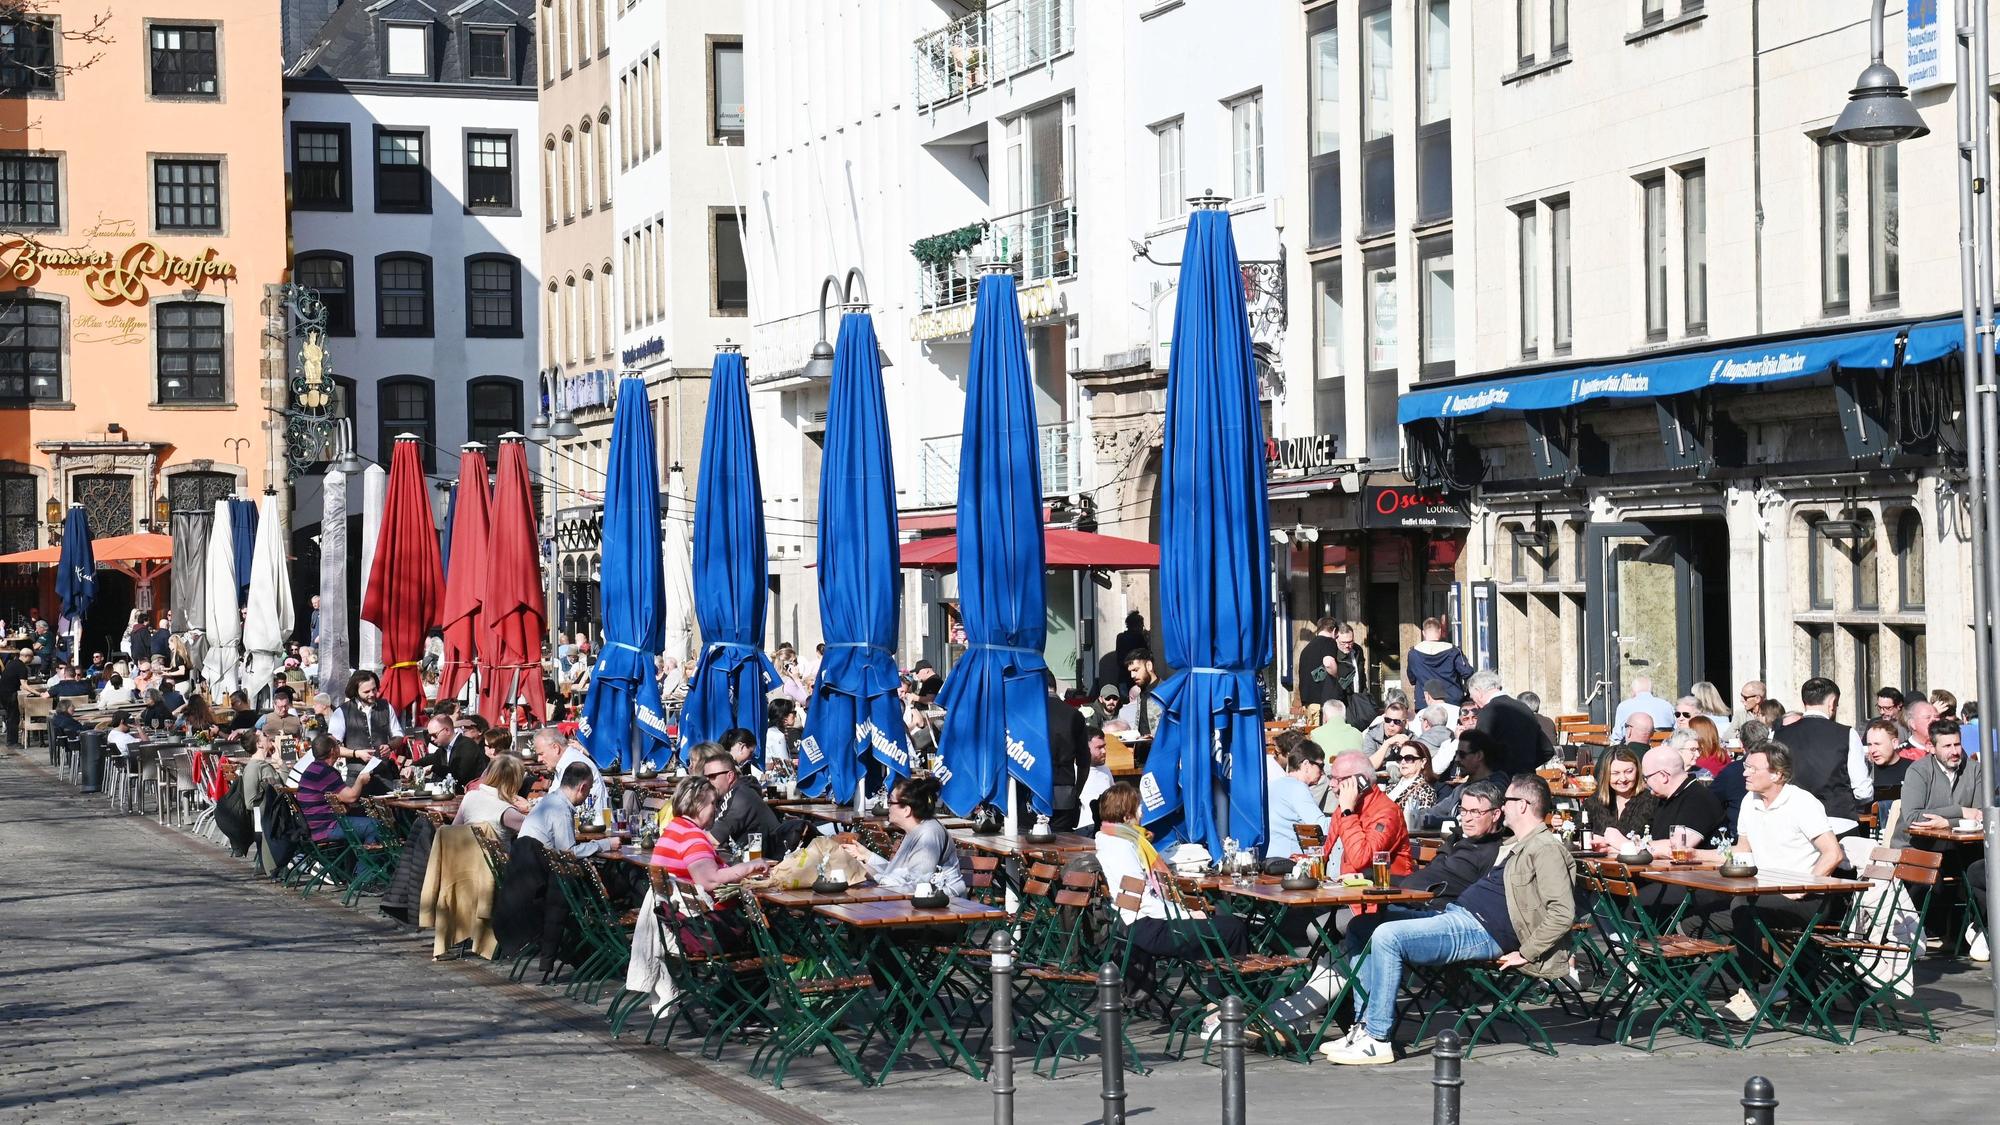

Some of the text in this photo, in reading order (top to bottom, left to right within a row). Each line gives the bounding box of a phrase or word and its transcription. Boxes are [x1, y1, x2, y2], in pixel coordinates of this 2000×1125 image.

[57, 268, 80, 277] zum
[83, 239, 232, 301] Pfaffen
[1279, 434, 1331, 469] LOUNGE
[1426, 505, 1459, 514] LOUNGE
